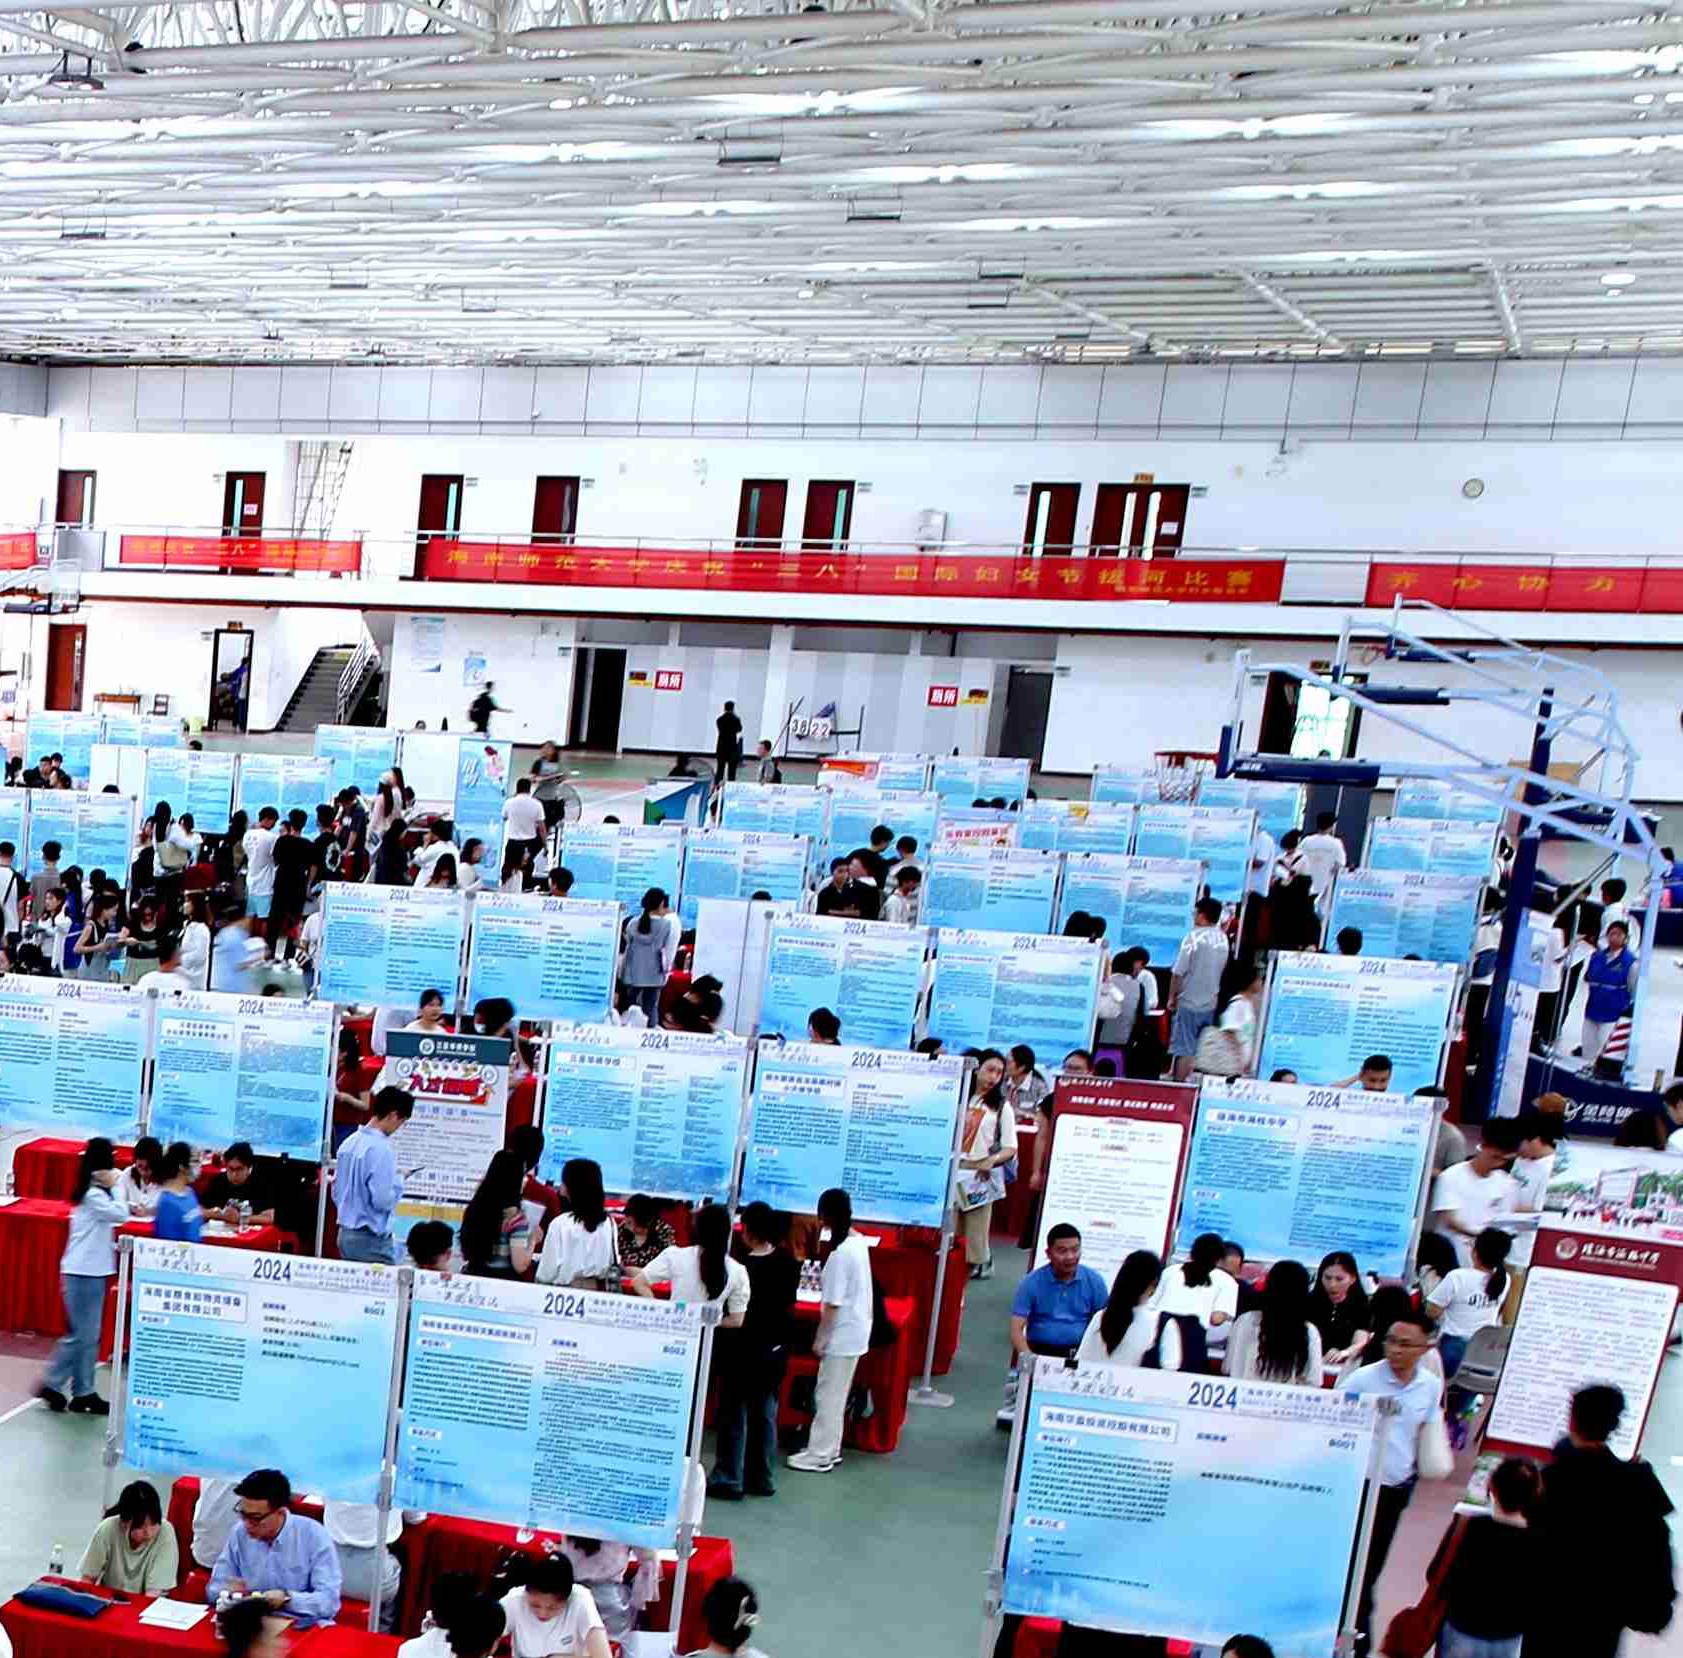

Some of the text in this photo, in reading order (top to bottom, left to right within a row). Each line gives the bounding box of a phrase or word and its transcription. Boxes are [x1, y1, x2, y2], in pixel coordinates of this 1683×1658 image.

[57, 982, 82, 998] 2024
[238, 999, 265, 1016] 2024
[640, 1034, 669, 1050] 2024
[852, 1050, 882, 1069] 2024
[1307, 1091, 1342, 1110] 2024
[254, 1258, 292, 1282] 2024
[544, 1292, 588, 1318] 2024
[1188, 1382, 1239, 1410] 2024
